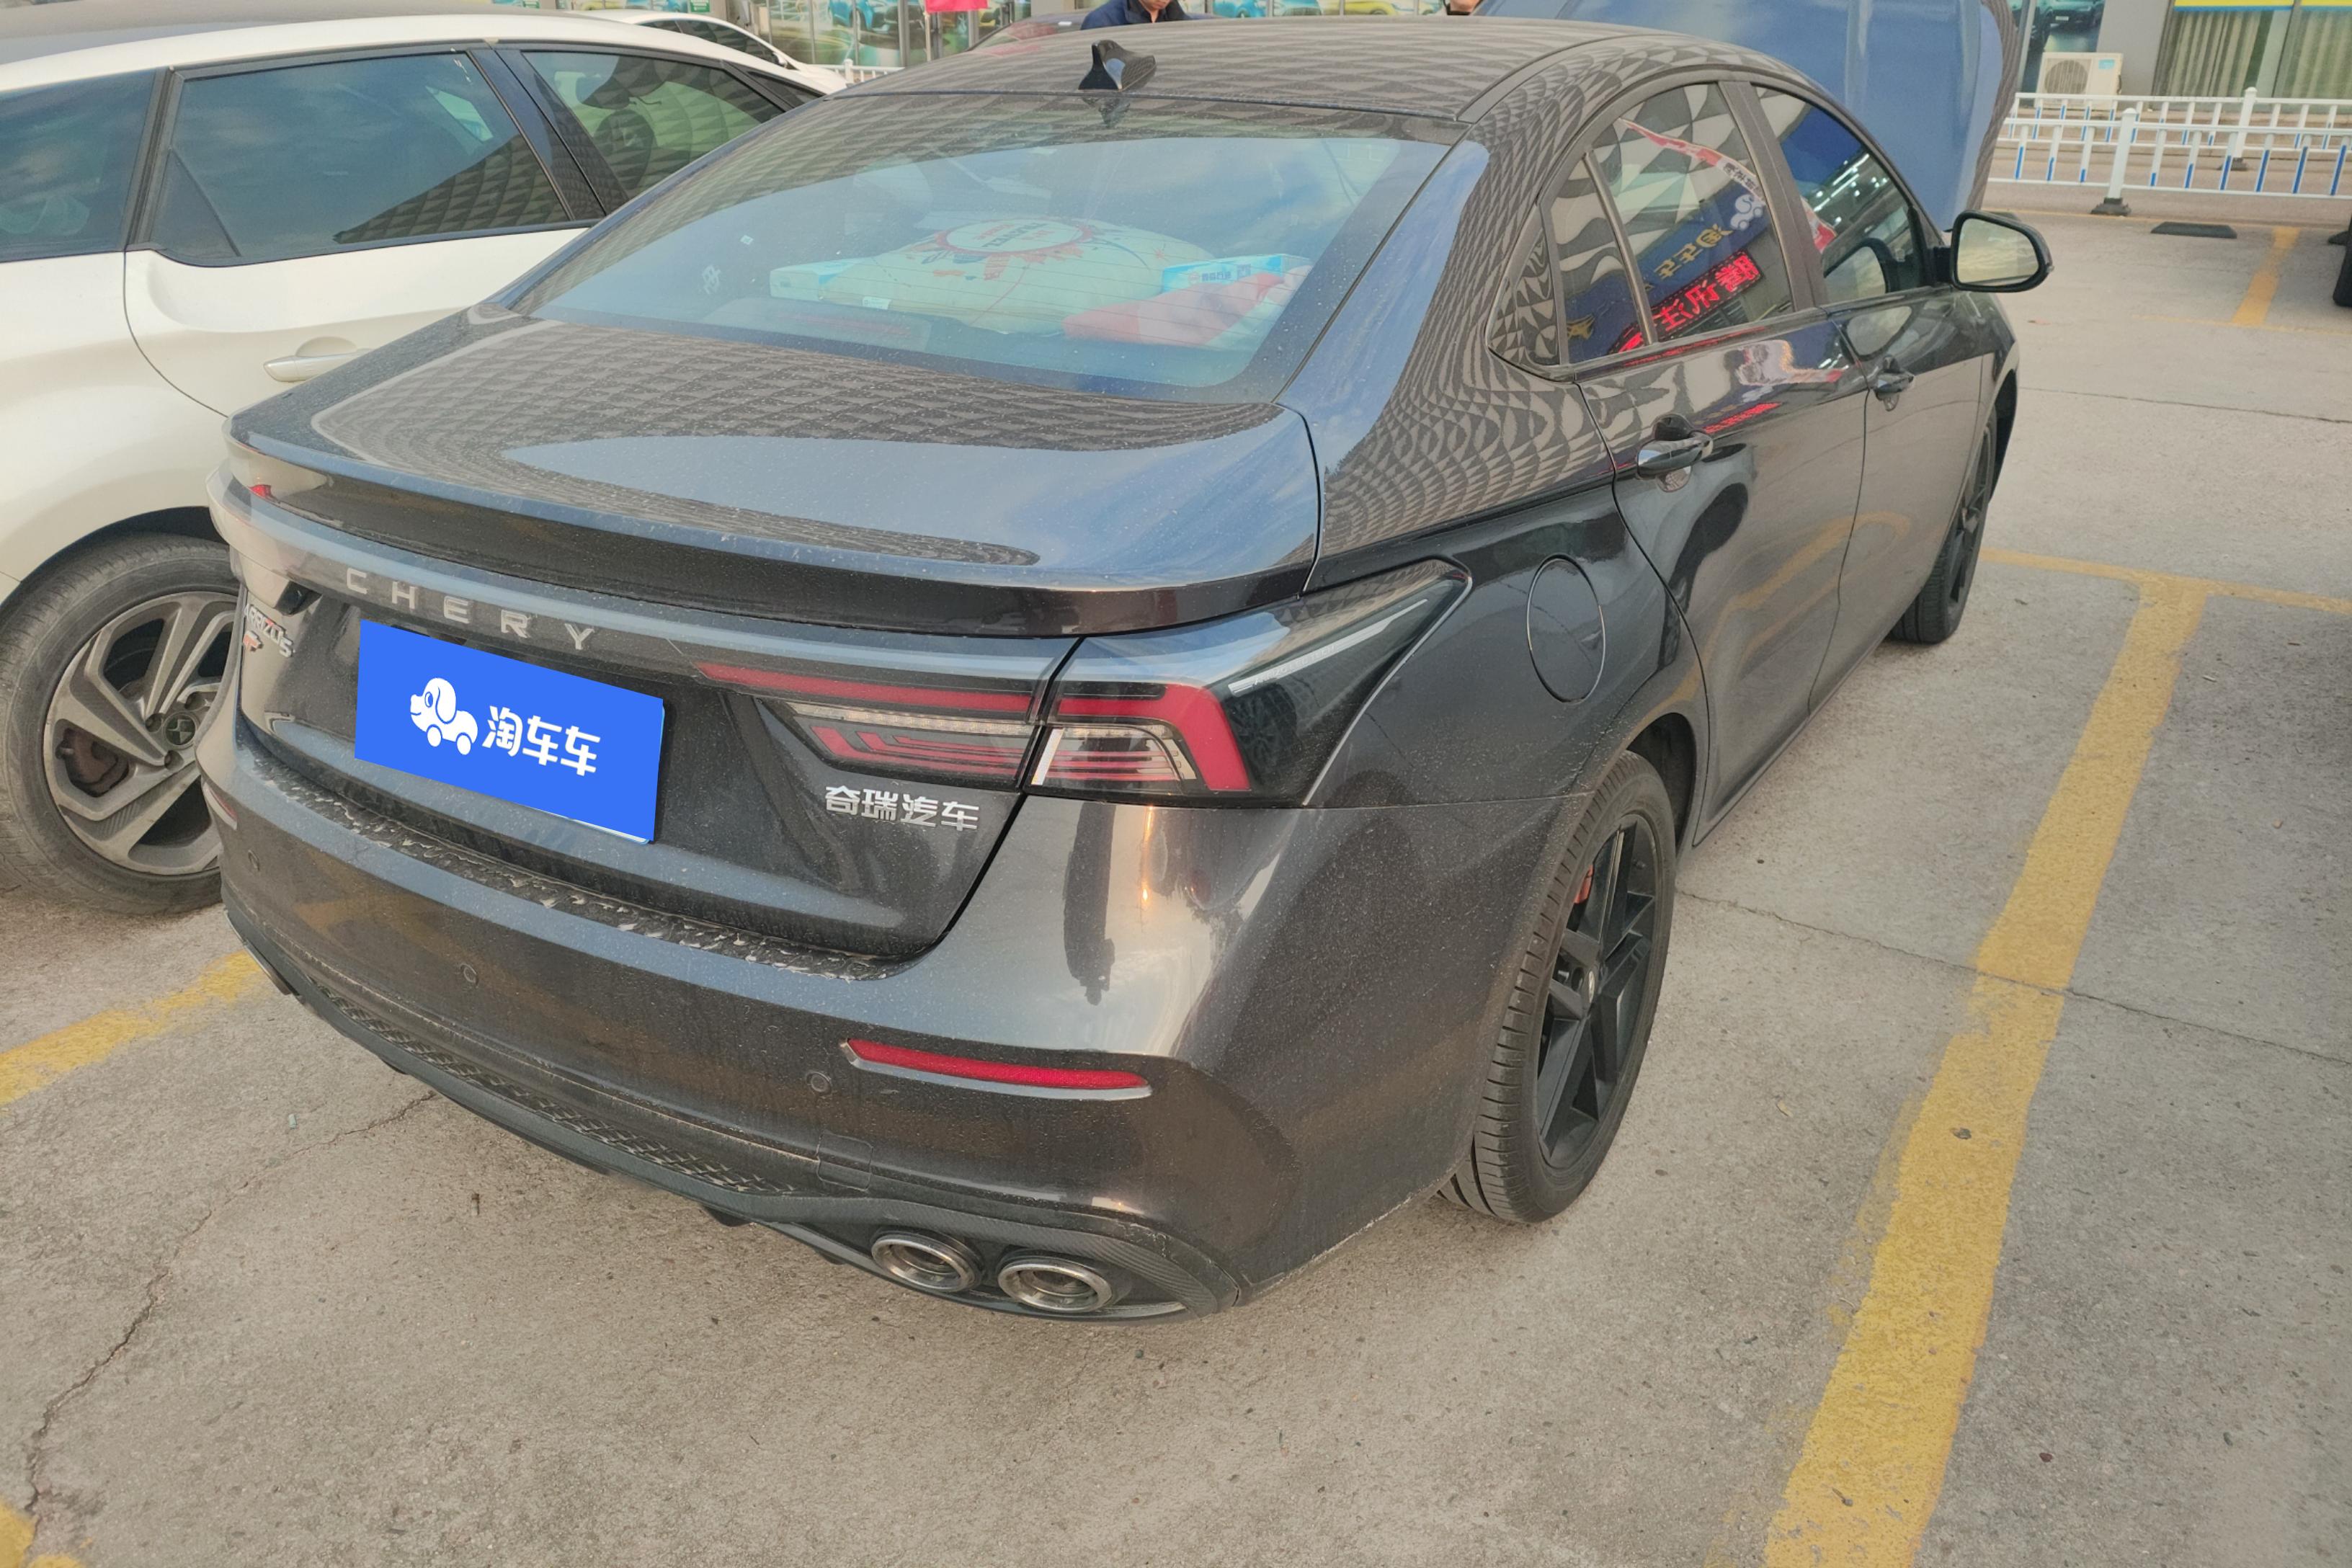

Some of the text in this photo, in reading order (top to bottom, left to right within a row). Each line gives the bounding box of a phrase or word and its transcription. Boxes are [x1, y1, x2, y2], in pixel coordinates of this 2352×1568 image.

[346, 567, 594, 650] CHERY
[824, 785, 979, 832] 奇瑞汽车
